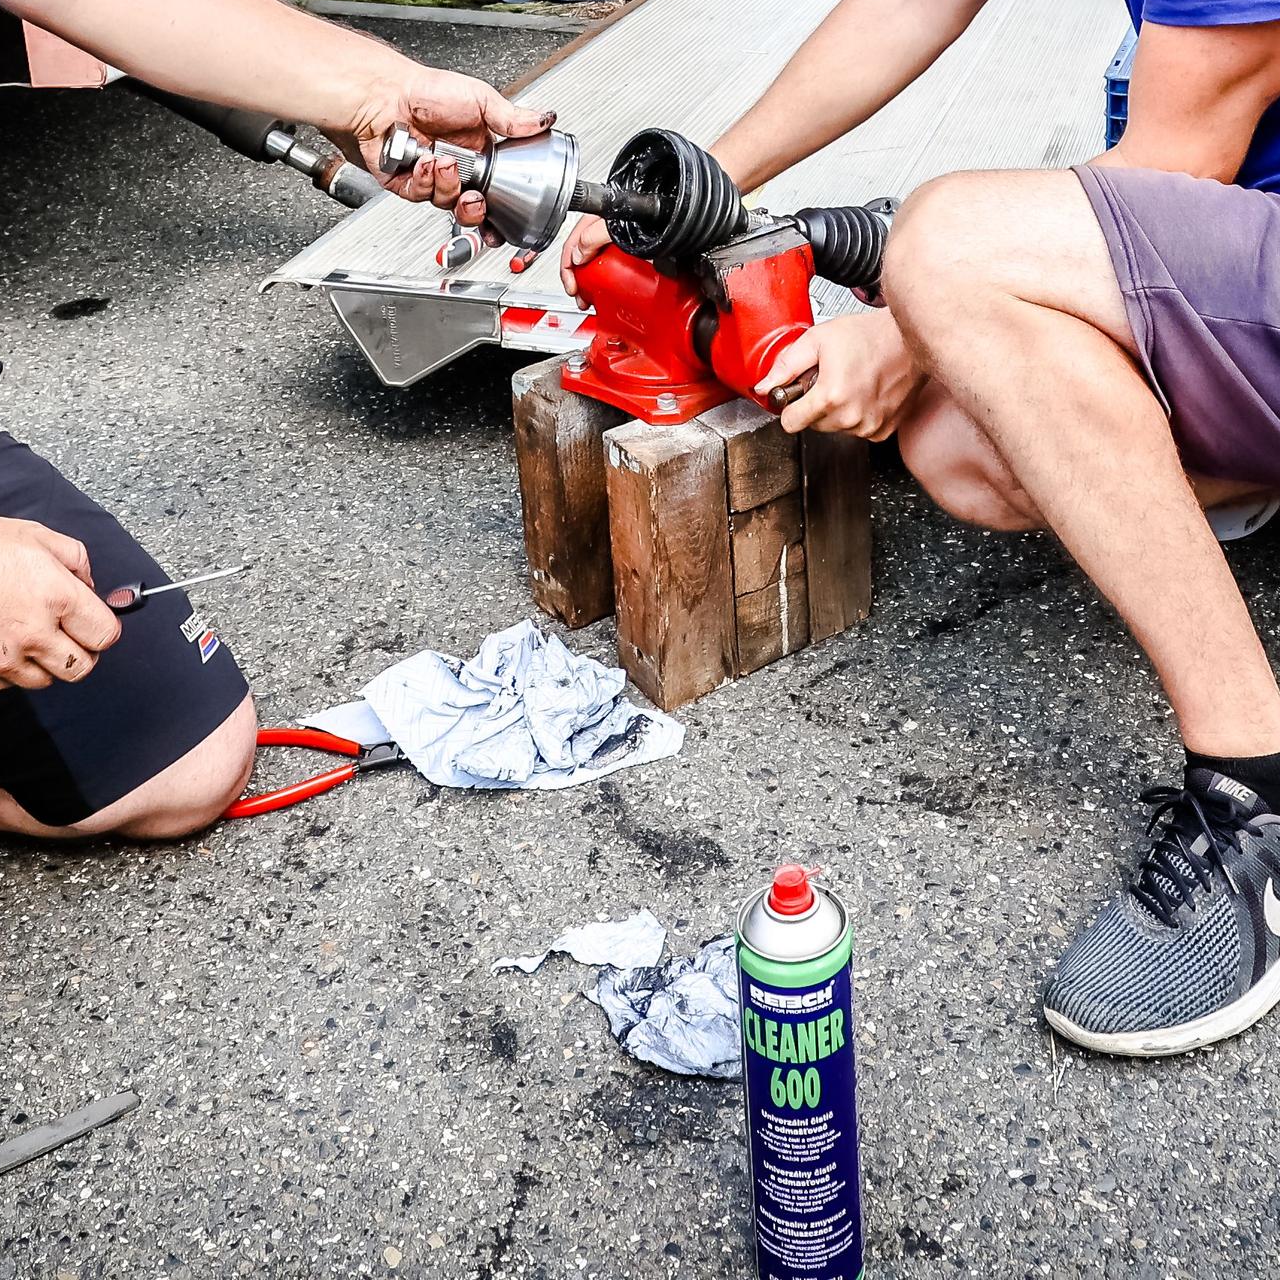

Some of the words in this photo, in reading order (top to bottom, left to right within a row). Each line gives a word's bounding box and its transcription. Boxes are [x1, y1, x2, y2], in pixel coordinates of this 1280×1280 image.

[1214, 777, 1254, 802] NIKE
[772, 1007, 786, 1015] FOR
[744, 1007, 845, 1064] CLEANER
[770, 1067, 821, 1110] 600
